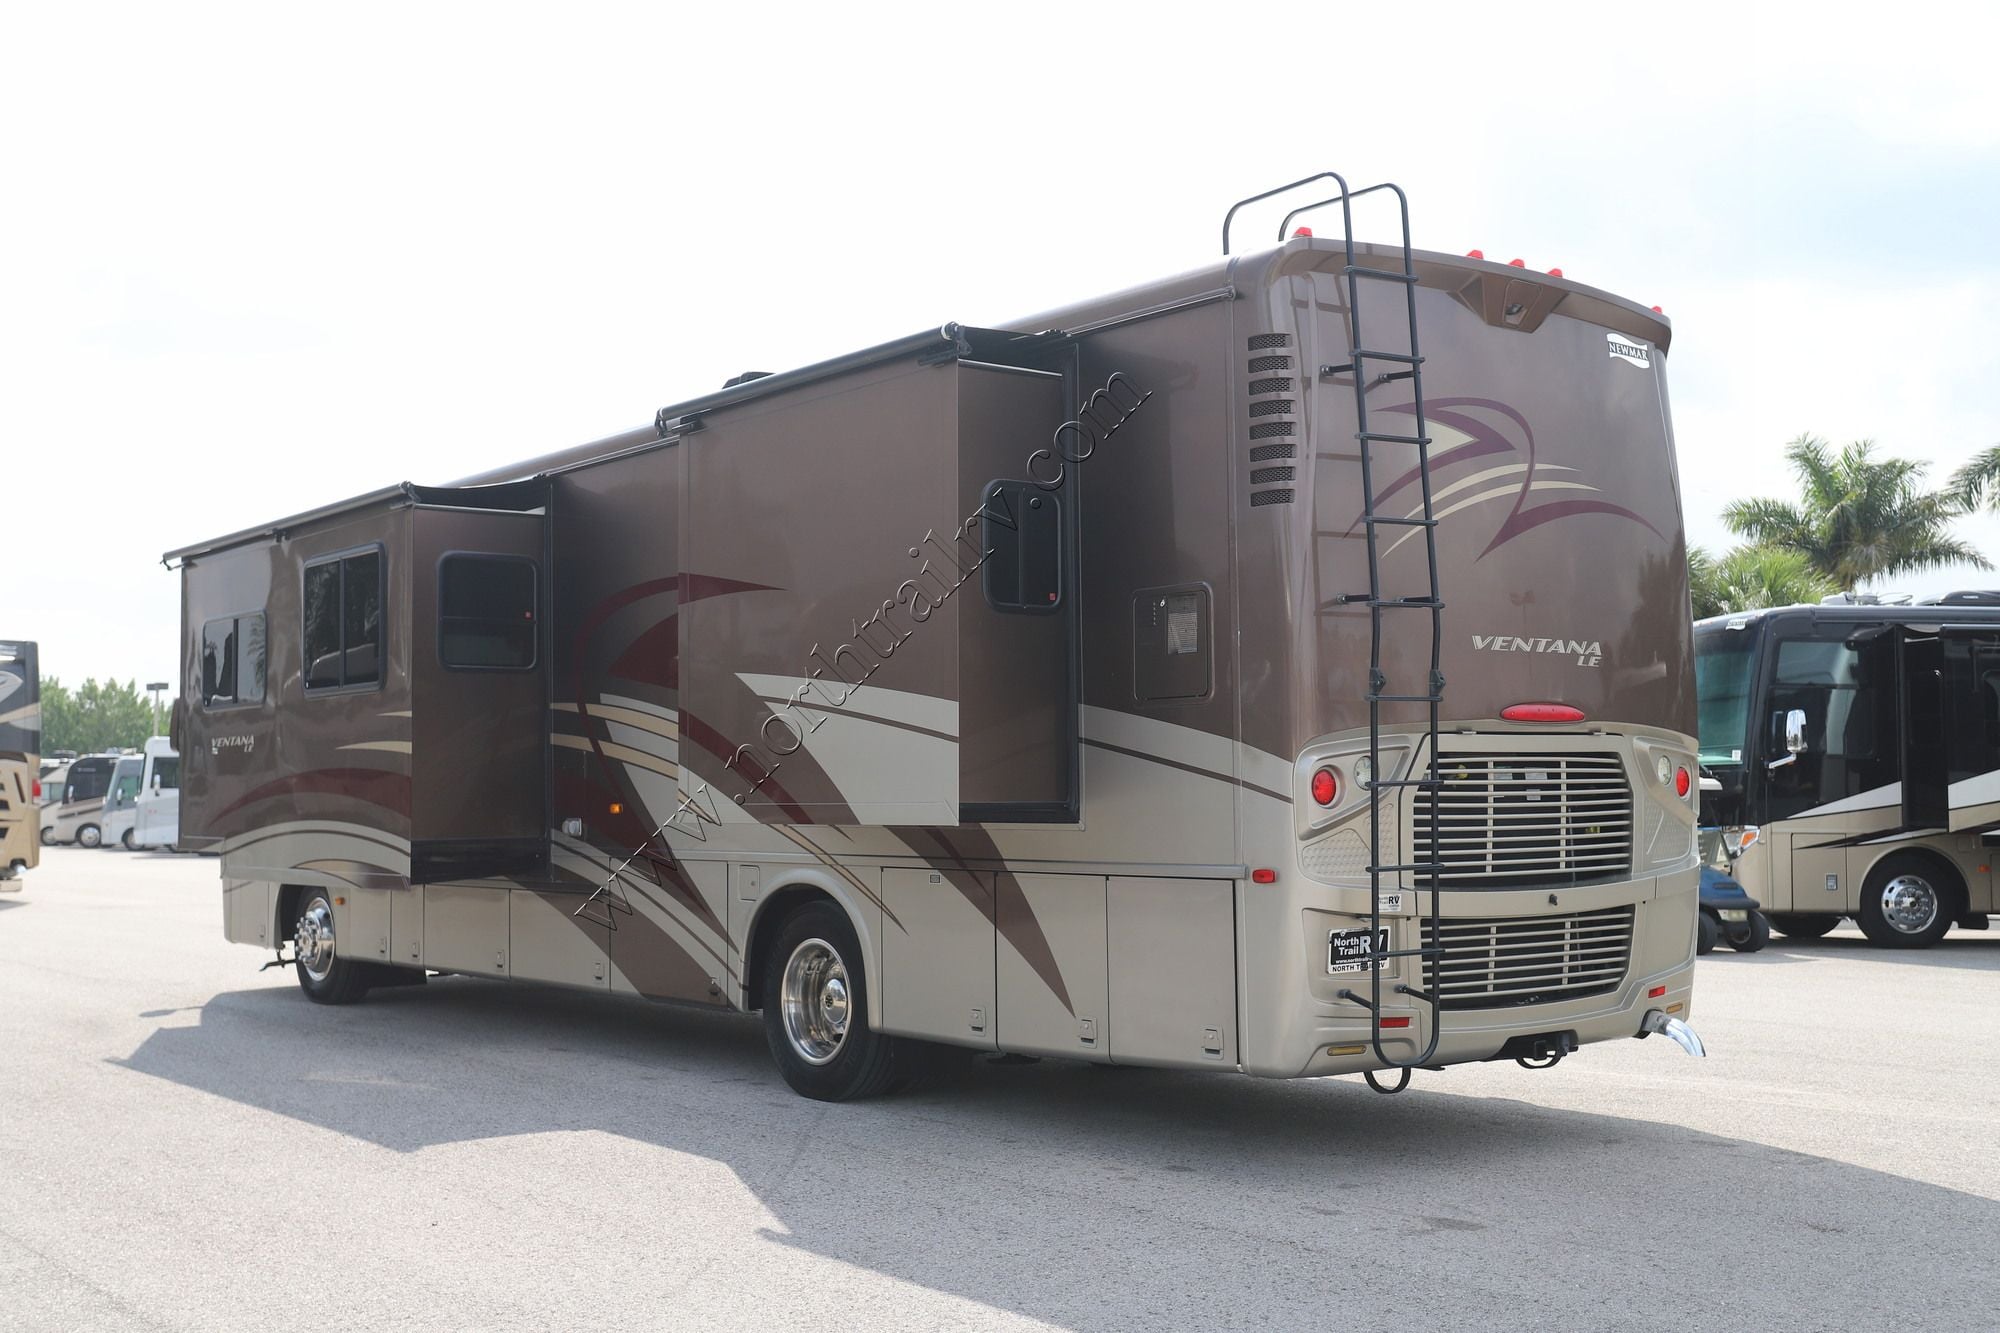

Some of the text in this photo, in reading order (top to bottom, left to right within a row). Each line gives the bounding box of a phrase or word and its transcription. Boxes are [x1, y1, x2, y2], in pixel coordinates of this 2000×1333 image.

[1608, 342, 1648, 360] NEWMAR
[1472, 635, 1602, 656] VENTANA
[1577, 655, 1602, 668] LE
[211, 734, 254, 747] VENTANA
[1334, 937, 1359, 947] North
[1338, 946, 1359, 955] Trail
[1332, 964, 1355, 972] NORTH
